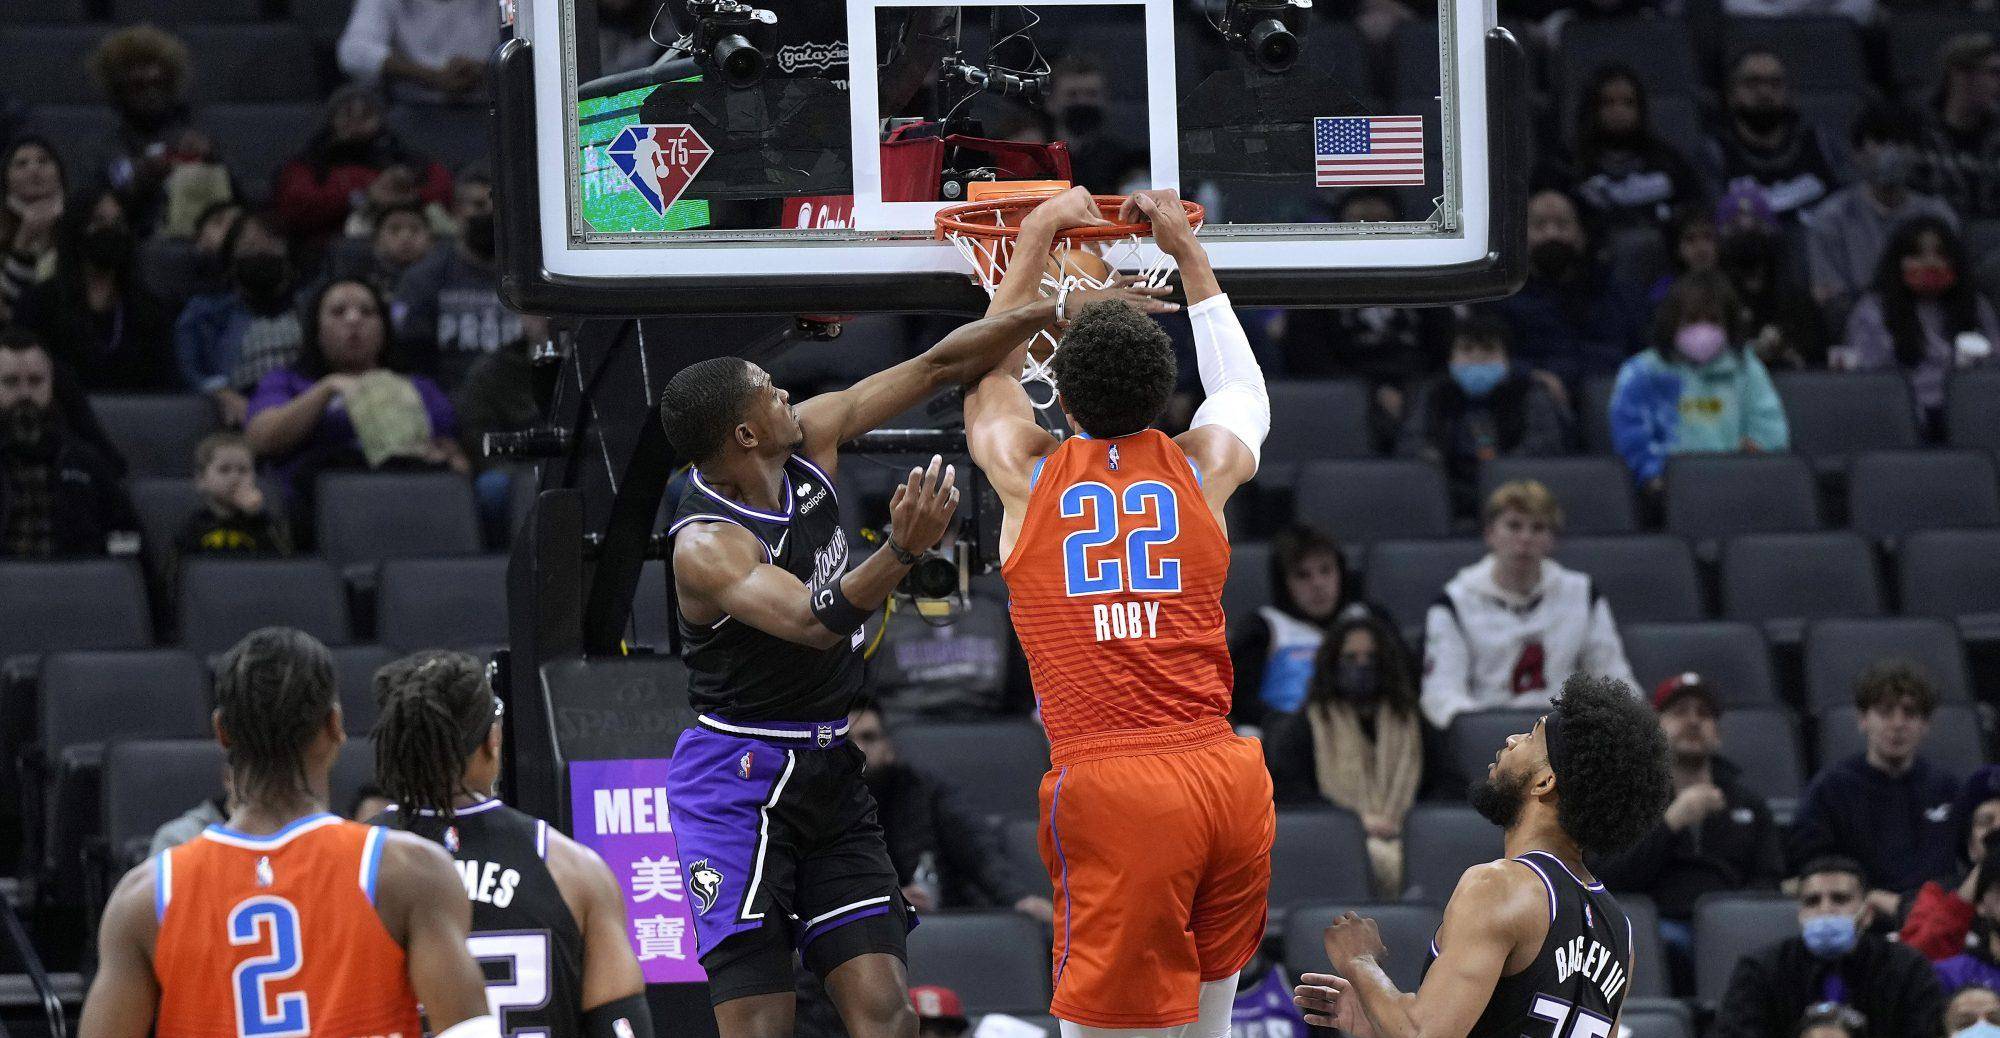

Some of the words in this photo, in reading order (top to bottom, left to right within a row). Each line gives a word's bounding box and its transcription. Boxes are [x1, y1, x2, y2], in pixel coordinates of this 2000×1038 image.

[668, 138, 689, 166] 75
[800, 486, 826, 514] dialpad
[1060, 480, 1182, 598] 22
[814, 589, 834, 611] 5
[1093, 601, 1160, 642] ROBY
[452, 859, 521, 908] MES
[227, 894, 311, 1038] 2
[1555, 935, 1611, 984] BAGEY
[1600, 960, 1626, 1004] III
